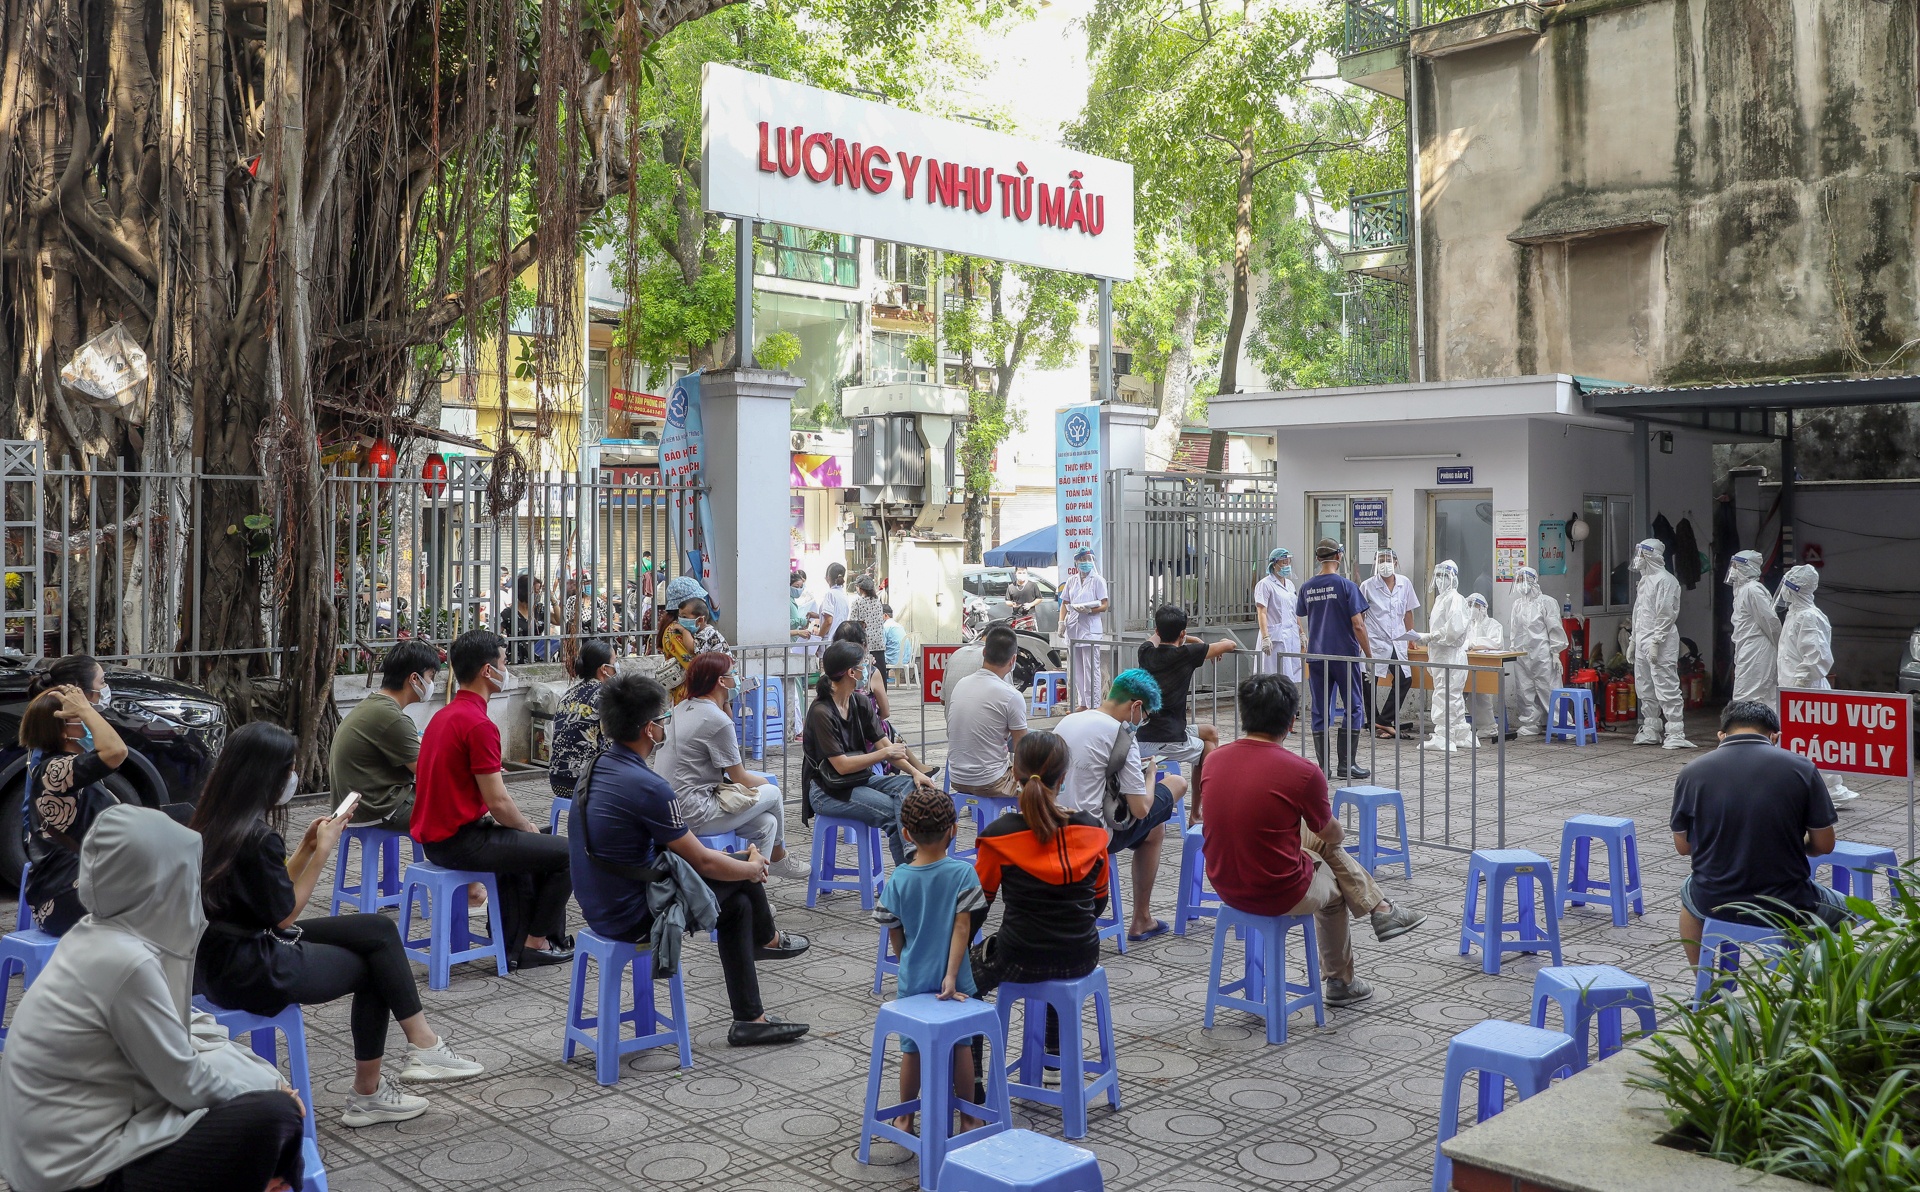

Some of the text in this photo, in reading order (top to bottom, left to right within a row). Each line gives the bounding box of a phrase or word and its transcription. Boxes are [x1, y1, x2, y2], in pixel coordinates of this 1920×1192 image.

[758, 121, 1104, 236] LƯƠNG Y NHƯ TỪ MẪU
[664, 449, 680, 462] BẢO
[1065, 462, 1092, 472] THỰC HIỆN
[1059, 475, 1071, 484] BẢO
[1072, 474, 1085, 484] HIỂM
[1091, 473, 1098, 482] TẾ
[1065, 528, 1077, 536] SỨC
[929, 653, 952, 670] KH
[1788, 700, 1896, 734] KHU VỰC
[1790, 734, 1895, 768] CÁCH LY
